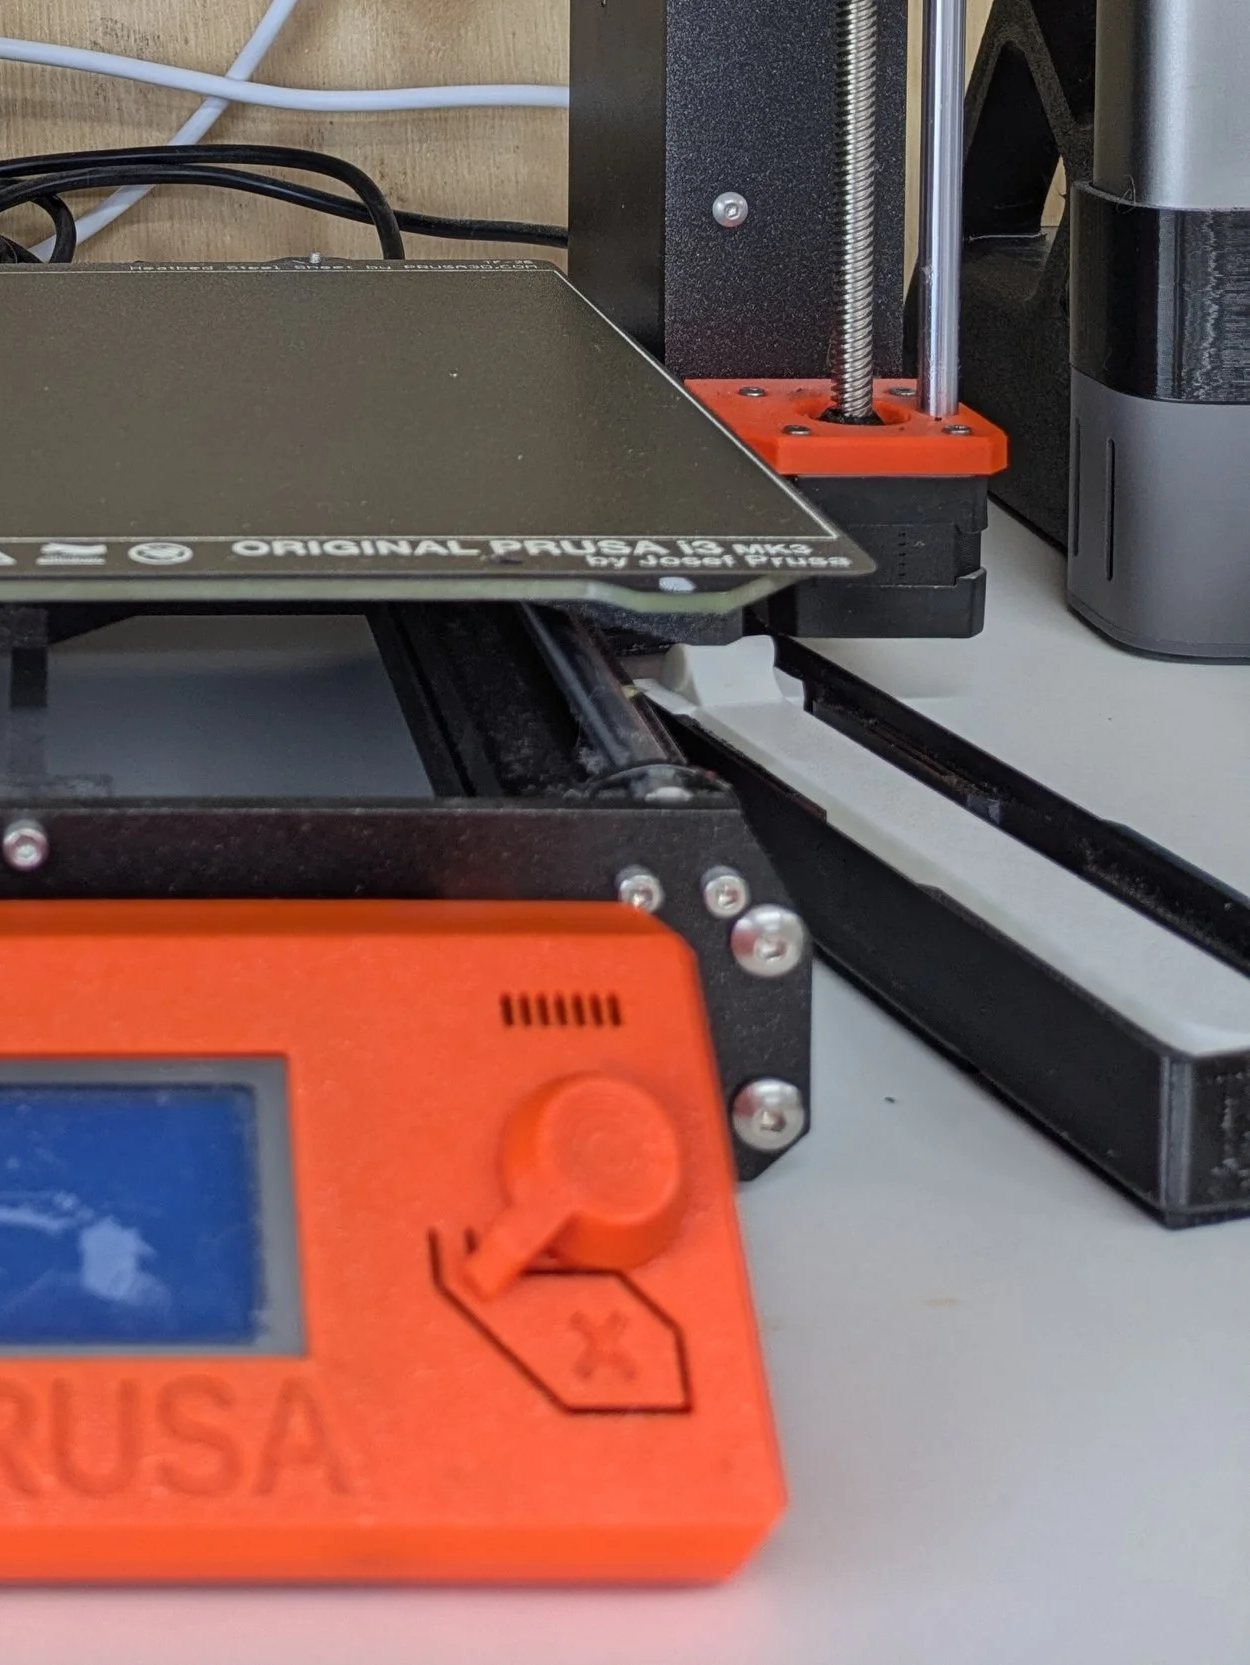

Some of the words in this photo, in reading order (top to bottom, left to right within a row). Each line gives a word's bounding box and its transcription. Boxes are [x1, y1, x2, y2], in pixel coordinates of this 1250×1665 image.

[231, 539, 481, 557] ORIGINAL
[489, 539, 670, 557] PRUSA
[676, 538, 725, 555] i3
[732, 542, 814, 555] MK3
[586, 554, 628, 569] by
[638, 554, 737, 568] Josef
[744, 553, 853, 568] Prusa
